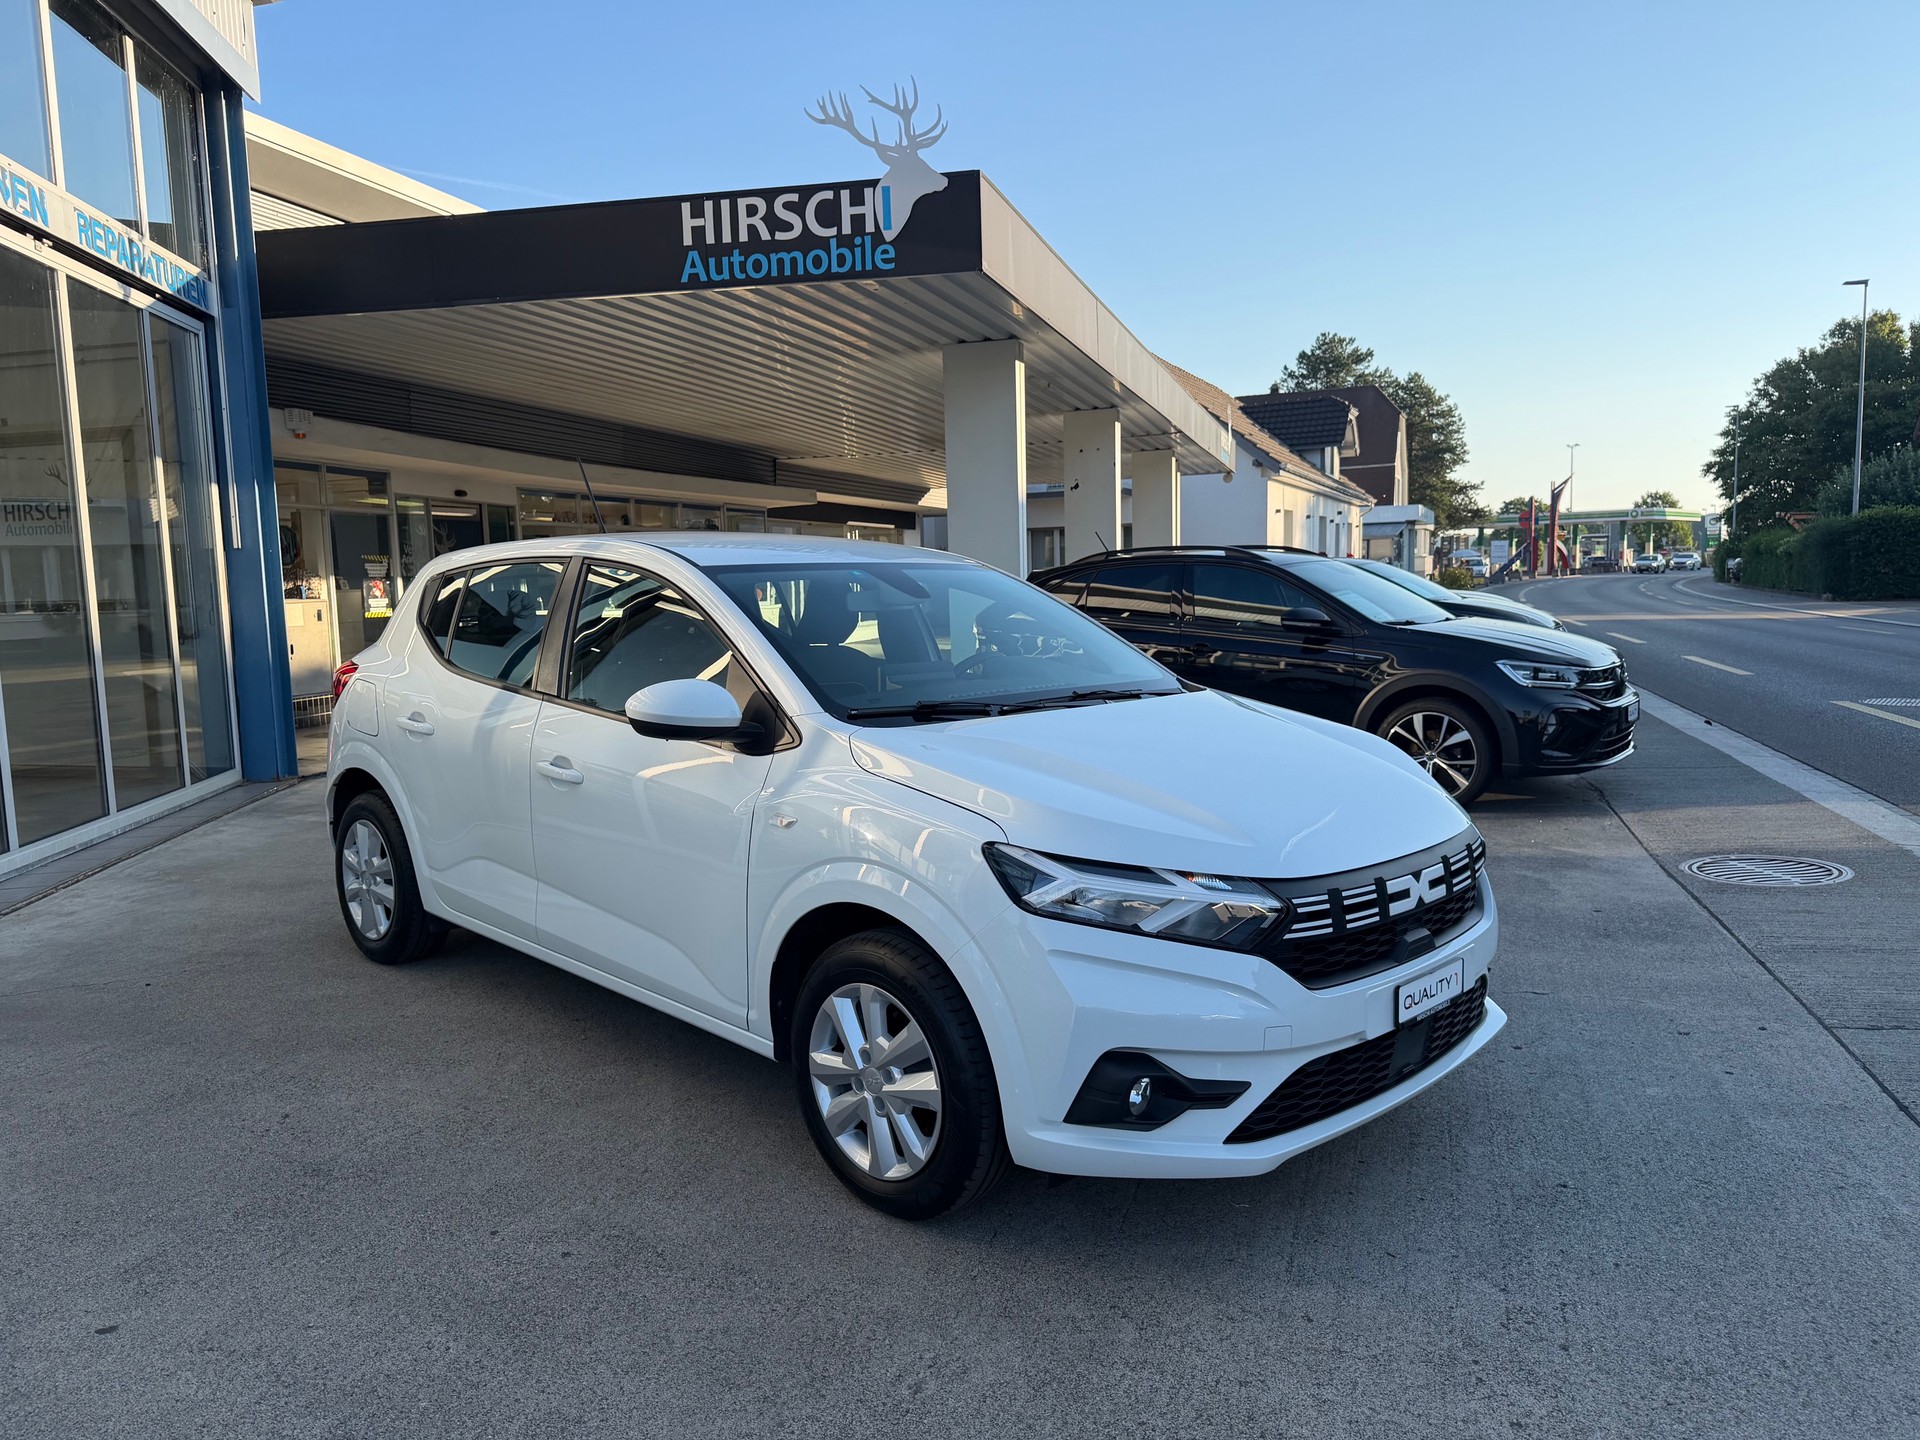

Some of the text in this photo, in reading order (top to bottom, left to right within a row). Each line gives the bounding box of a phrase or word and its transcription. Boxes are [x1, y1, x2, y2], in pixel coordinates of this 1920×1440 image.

[681, 185, 893, 247] HIRSCHI
[73, 207, 210, 311] REPARATUREN
[680, 235, 896, 283] Automobile
[1403, 972, 1459, 1010] QUALITY 1
